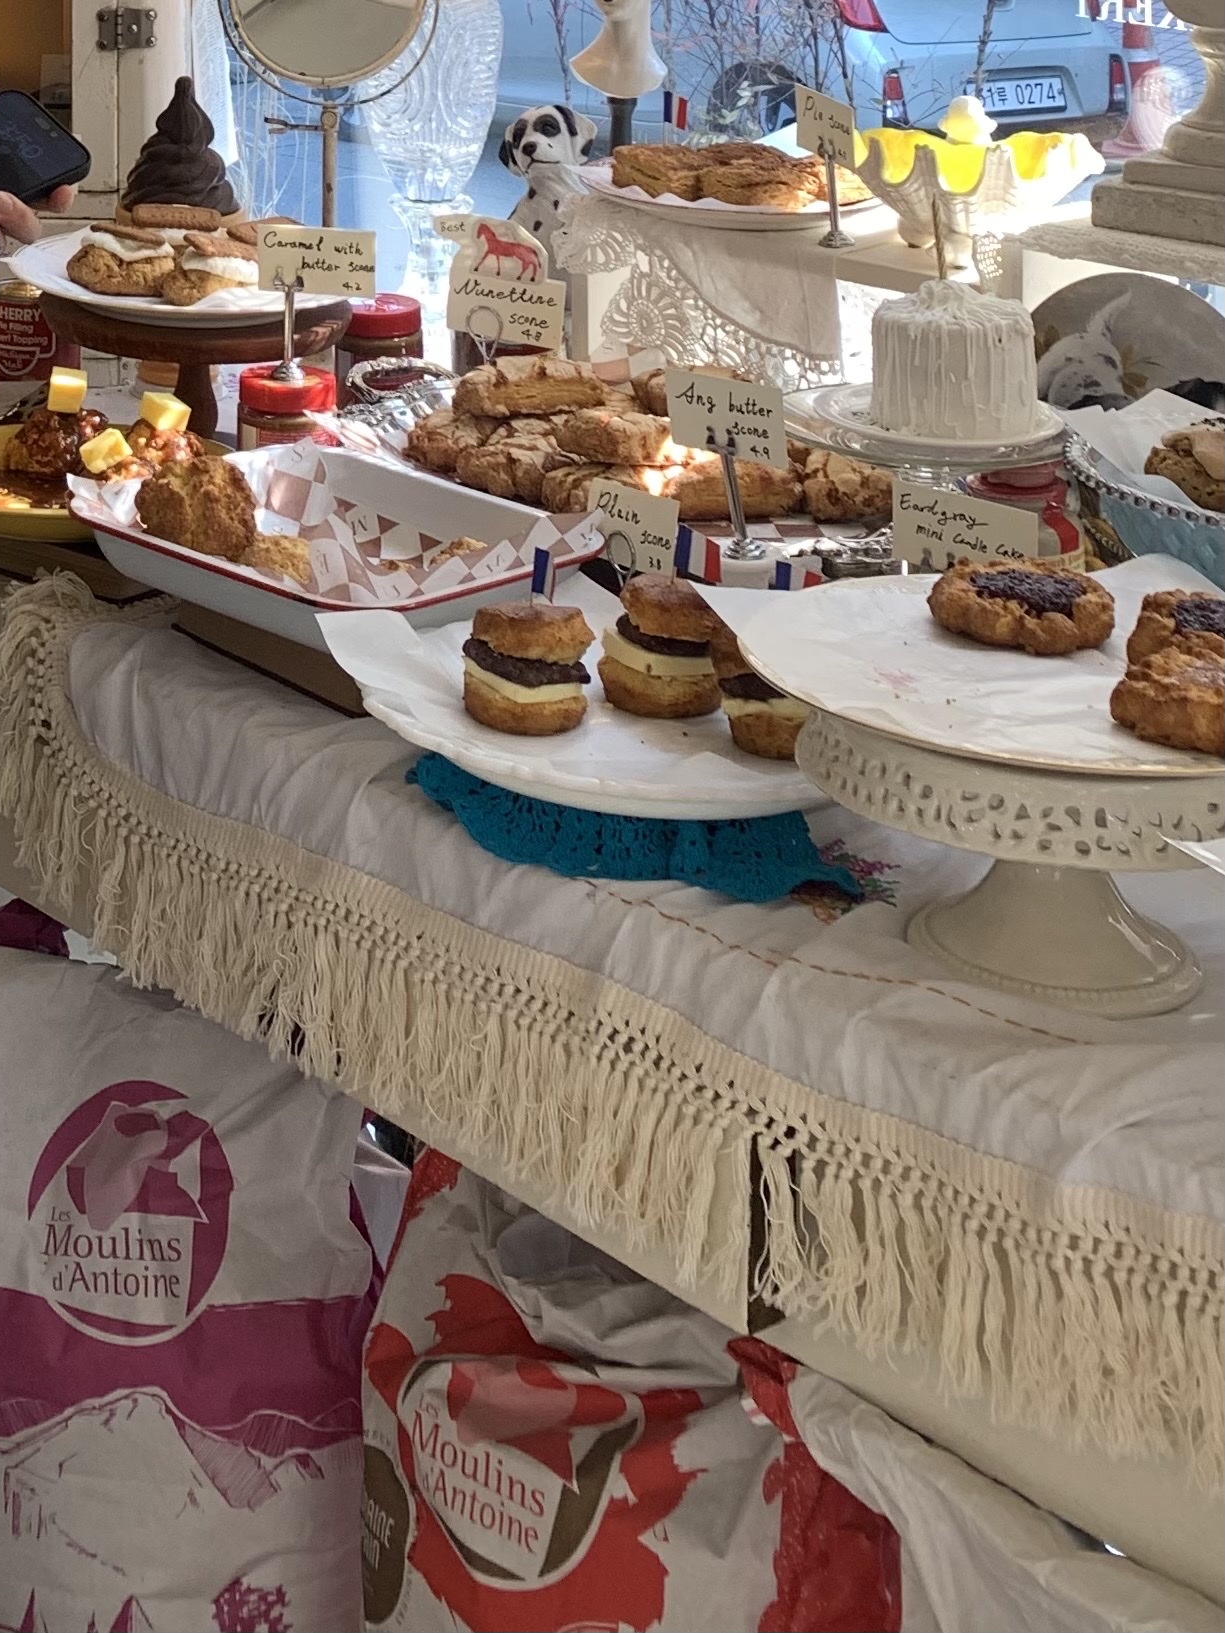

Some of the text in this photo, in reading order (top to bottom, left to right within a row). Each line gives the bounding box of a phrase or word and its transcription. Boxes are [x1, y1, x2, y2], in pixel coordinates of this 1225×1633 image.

[1014, 82, 1056, 105] 0274
[803, 96, 824, 121] Pie
[264, 230, 364, 256] Caramel with
[301, 255, 341, 272] butter
[8, 321, 34, 334] Filling
[508, 313, 550, 330] scone
[12, 334, 49, 347] Topping
[675, 381, 774, 418] Ang butter
[596, 489, 642, 525] Plain
[639, 529, 672, 551] scone
[915, 524, 944, 542] mini
[952, 533, 988, 554] Candle
[51, 1206, 72, 1222] Les
[40, 1223, 182, 1262] Moulins
[52, 1261, 181, 1299] d'Antoine
[412, 1408, 546, 1519] Moulins
[422, 1465, 540, 1555] d'Antoine
